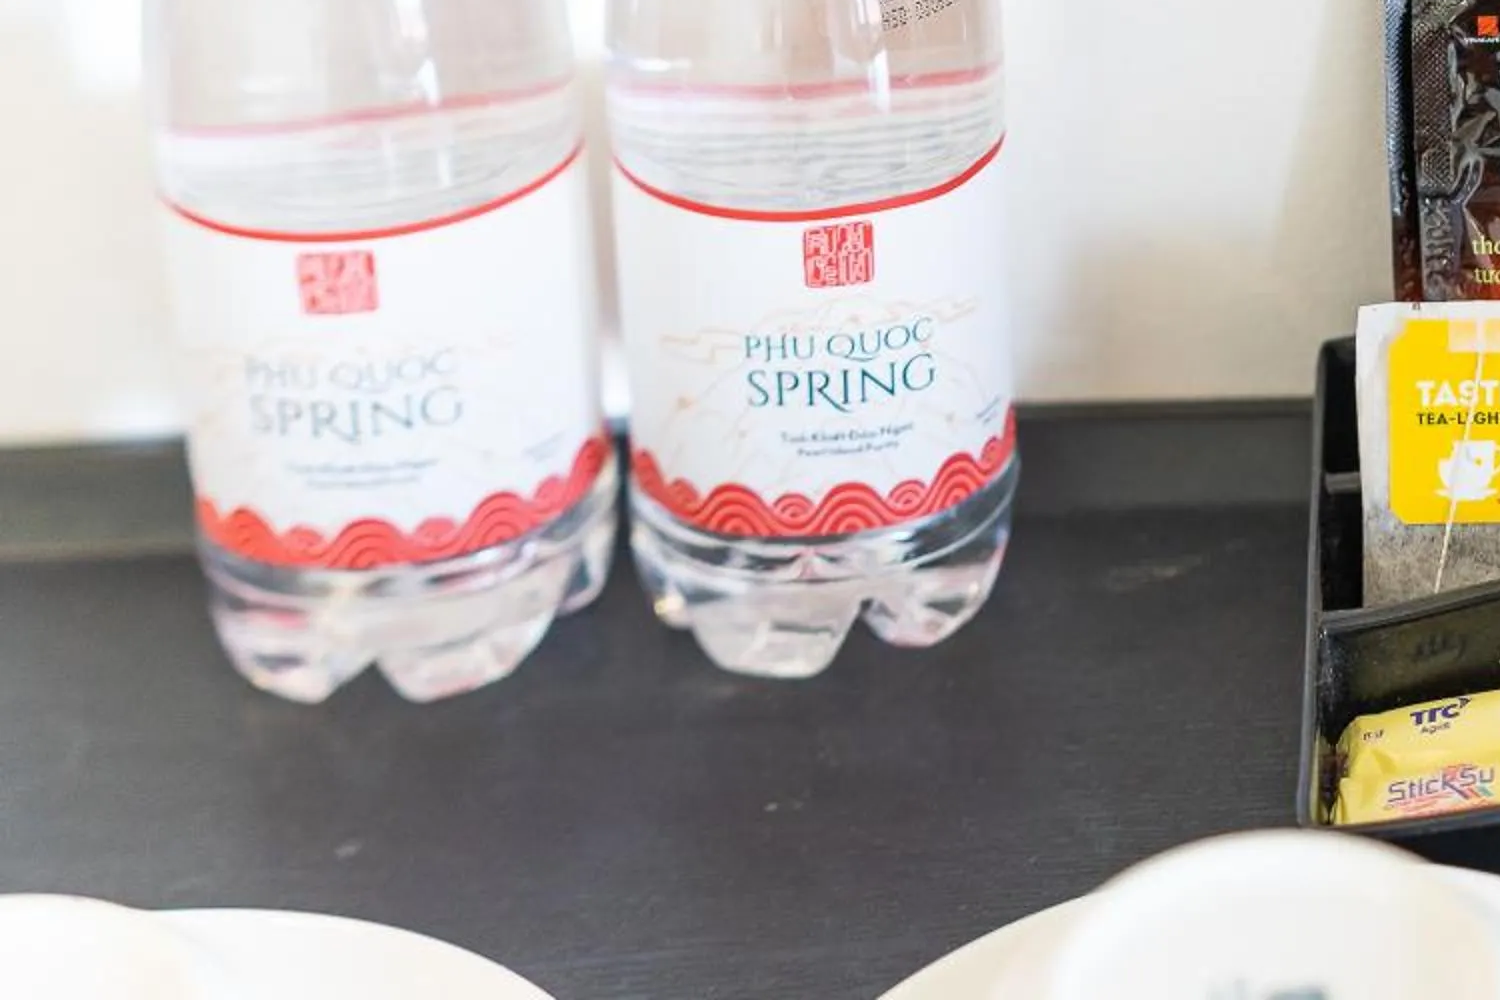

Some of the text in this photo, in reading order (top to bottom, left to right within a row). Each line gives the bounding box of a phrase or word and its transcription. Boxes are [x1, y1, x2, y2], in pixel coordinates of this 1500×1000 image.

[744, 317, 933, 363] PHU QUOC
[746, 353, 936, 414] SPRING
[249, 384, 464, 445] SPRING
[1410, 703, 1460, 726] TTC
